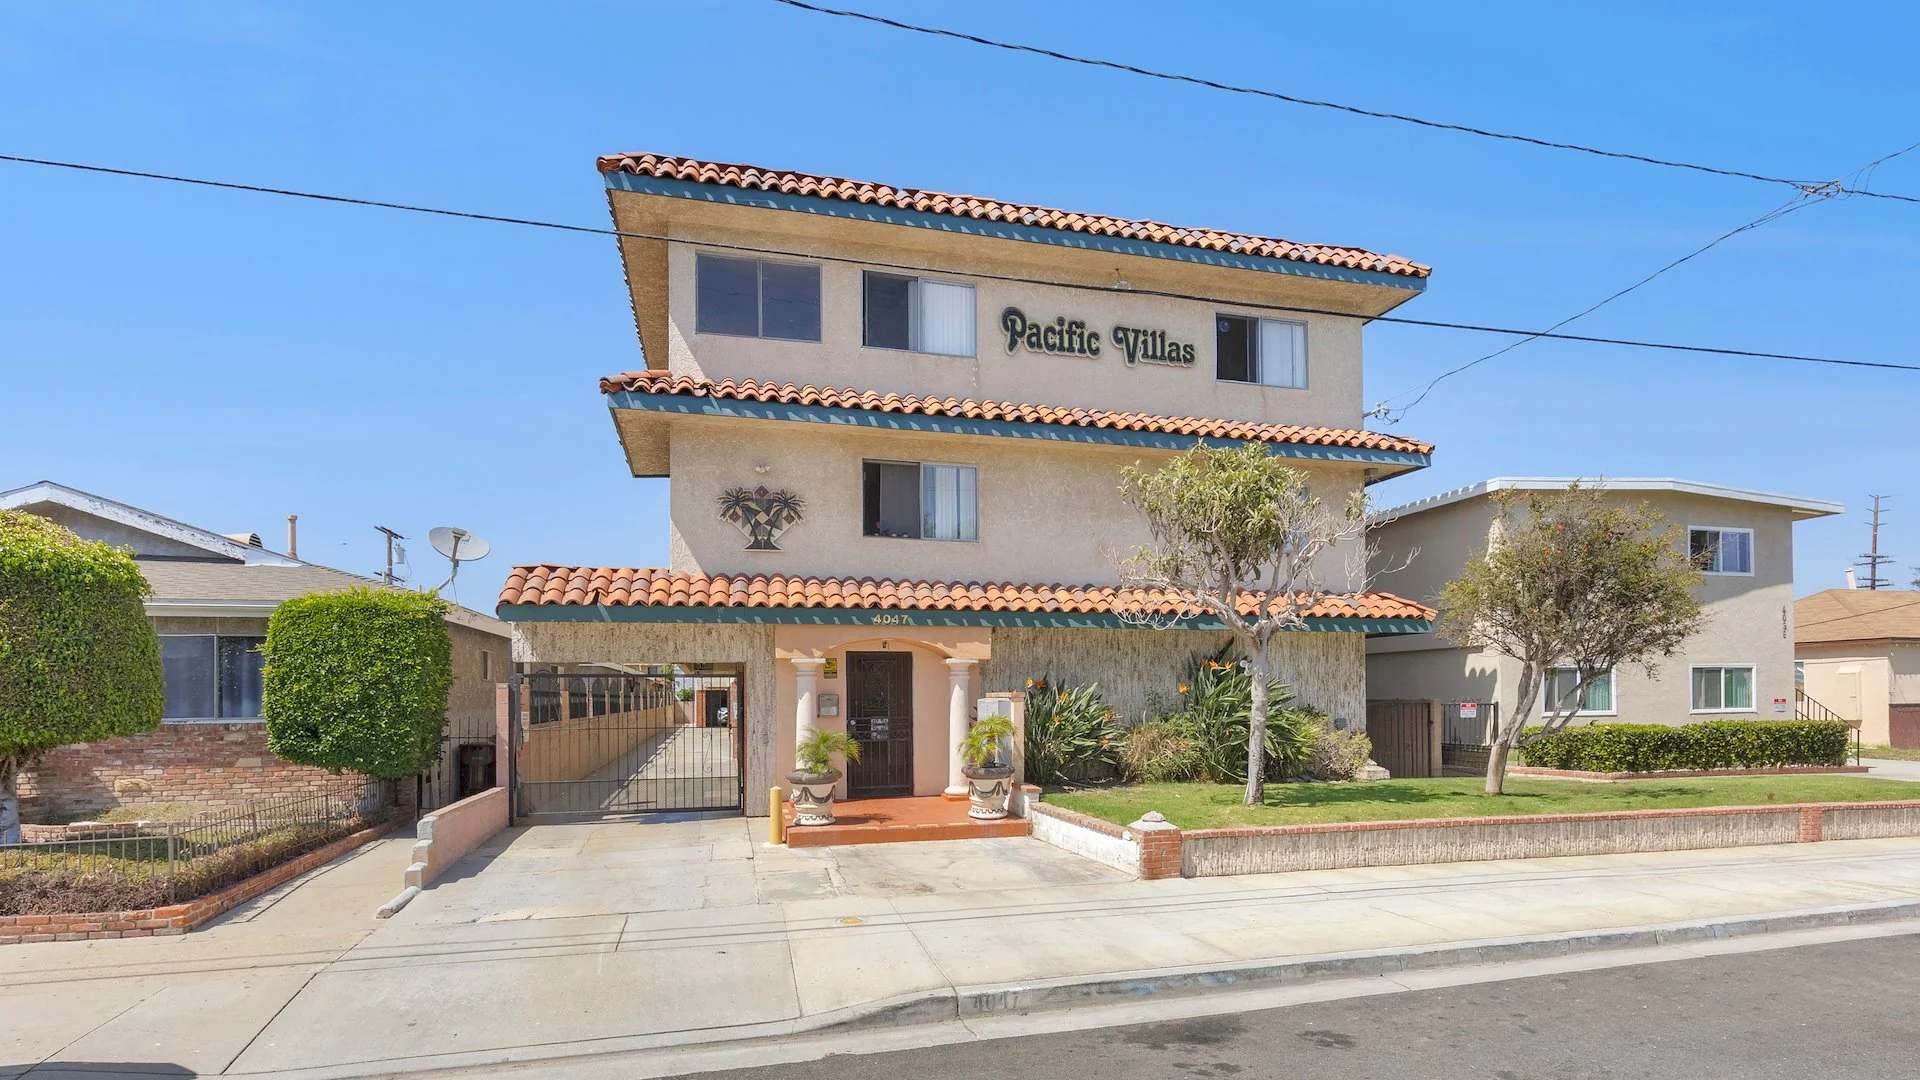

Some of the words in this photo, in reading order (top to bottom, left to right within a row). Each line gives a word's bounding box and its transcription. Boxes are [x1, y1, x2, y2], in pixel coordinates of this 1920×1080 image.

[1001, 306, 1101, 358] Pacific
[1111, 324, 1196, 367] Villas
[873, 614, 909, 625] 4047
